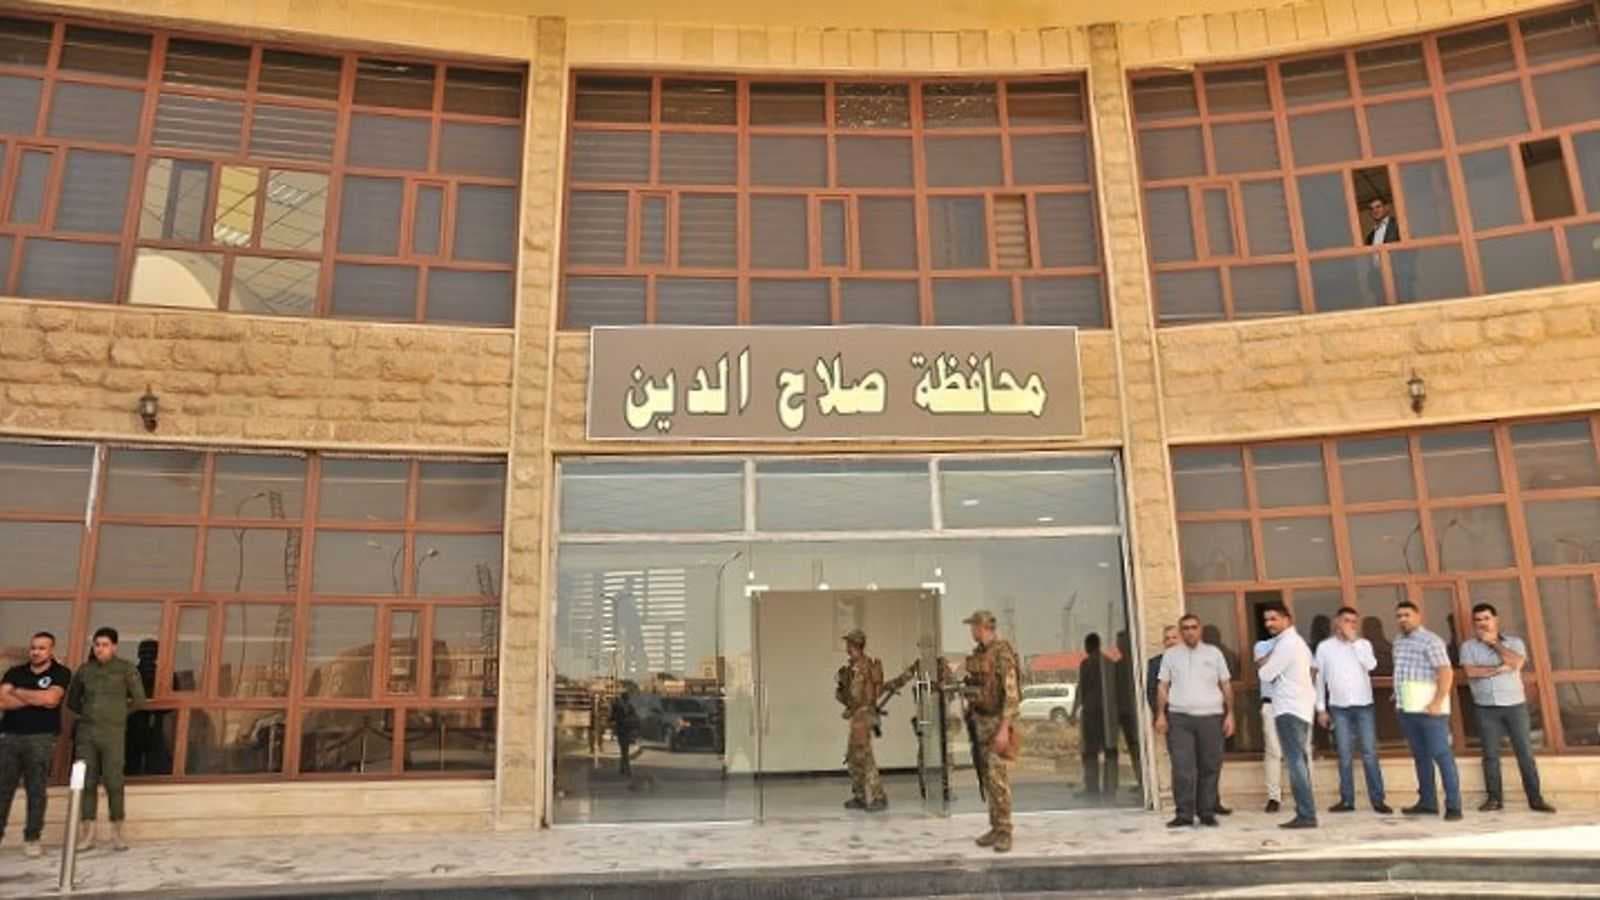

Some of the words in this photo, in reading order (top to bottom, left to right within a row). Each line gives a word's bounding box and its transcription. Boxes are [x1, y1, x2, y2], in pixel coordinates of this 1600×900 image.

[623, 346, 751, 432] الدين
[776, 352, 888, 430] صلاح
[911, 352, 1047, 417] محافظة
